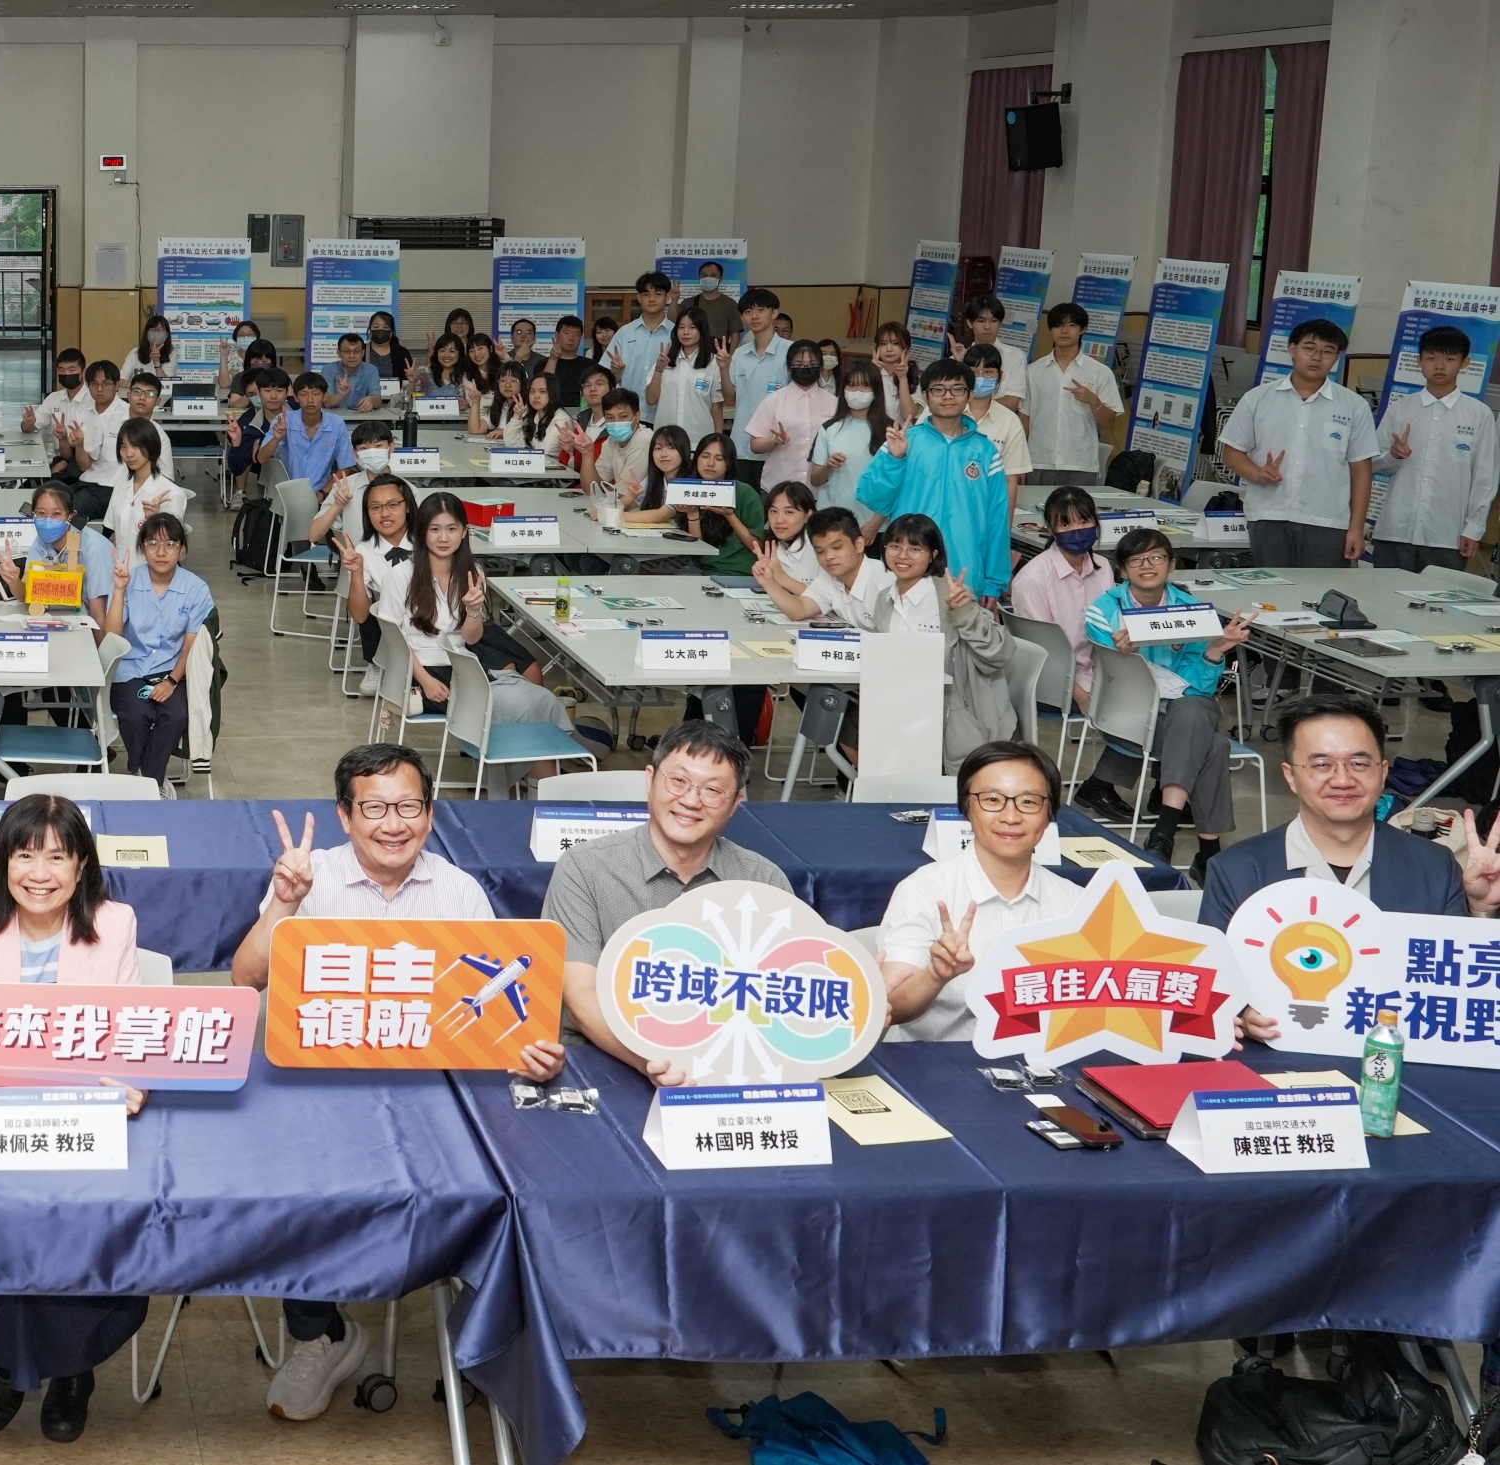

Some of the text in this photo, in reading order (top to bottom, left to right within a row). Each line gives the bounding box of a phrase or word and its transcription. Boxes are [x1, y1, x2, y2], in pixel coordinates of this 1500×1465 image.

[312, 248, 394, 256] 新北市私立淡江高級中學
[664, 248, 738, 256] 新北市立林口高級中學
[1283, 285, 1351, 301] 新北市立光復高級中學
[1413, 297, 1497, 315] 新北市立金山高級中學
[683, 490, 717, 499] 秀峰高中
[1149, 619, 1197, 630] 南山高中
[664, 649, 708, 660] 北大高中
[303, 940, 436, 993] 自主
[1405, 938, 1500, 988] 點亮
[631, 960, 851, 1021] 跨域不設限
[1013, 966, 1200, 1006] 最佳人氣獎
[297, 998, 433, 1048] 領航
[1344, 987, 1500, 1046] 新視野
[1368, 1051, 1387, 1084] 原萃
[4, 1117, 80, 1128] 國立臺灣師範大學
[717, 1115, 773, 1127] 國立臺灣大學
[1245, 1119, 1317, 1131] 國立陽明交通大學
[55, 1132, 95, 1153] 教授
[695, 1129, 799, 1152] 林國明 教授
[1233, 1133, 1336, 1157] 陳鏗任 教授
